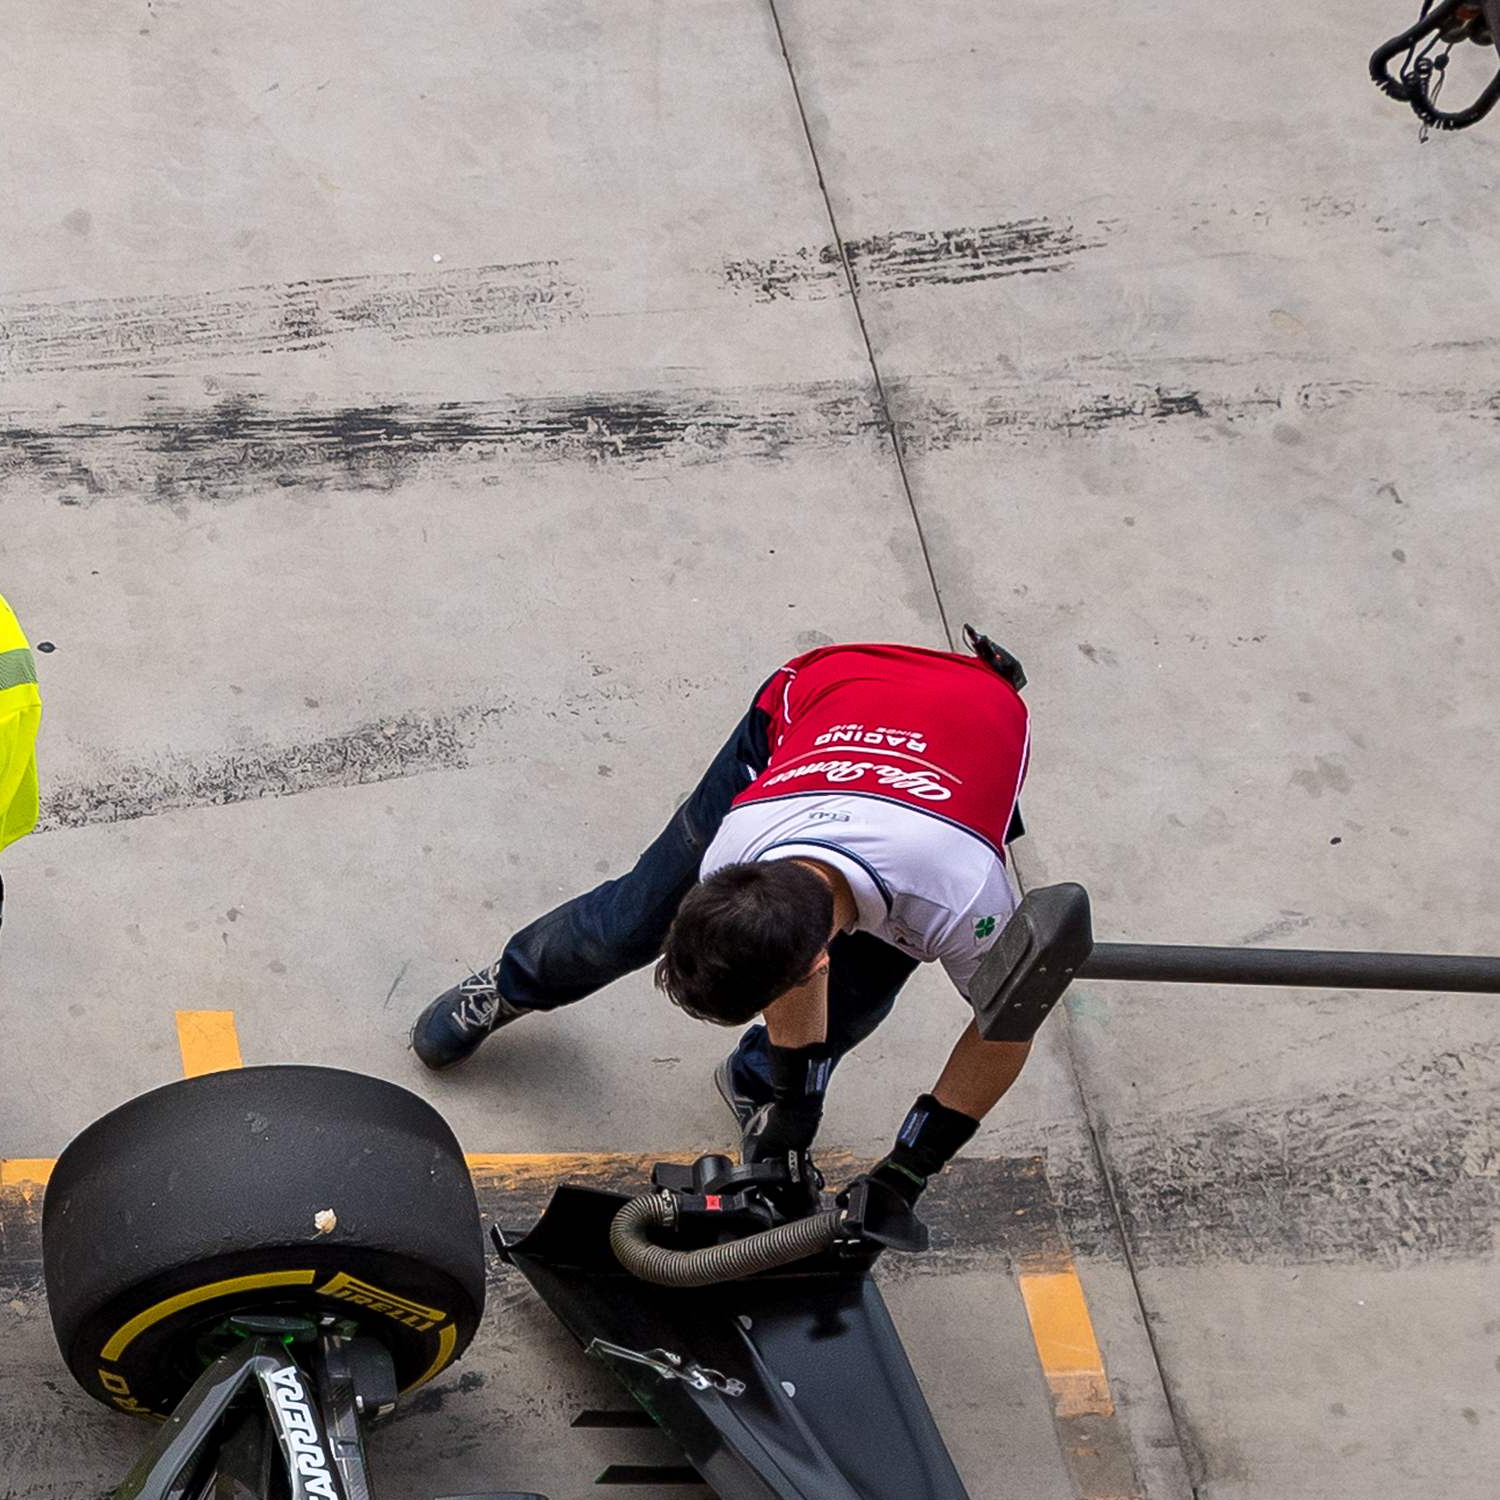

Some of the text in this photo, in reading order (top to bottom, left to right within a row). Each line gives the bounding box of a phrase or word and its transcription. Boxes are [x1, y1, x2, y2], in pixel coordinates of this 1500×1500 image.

[814, 731, 928, 753] RACING
[762, 760, 952, 801] Alfa Romeo
[315, 1271, 447, 1333] PIRELLI
